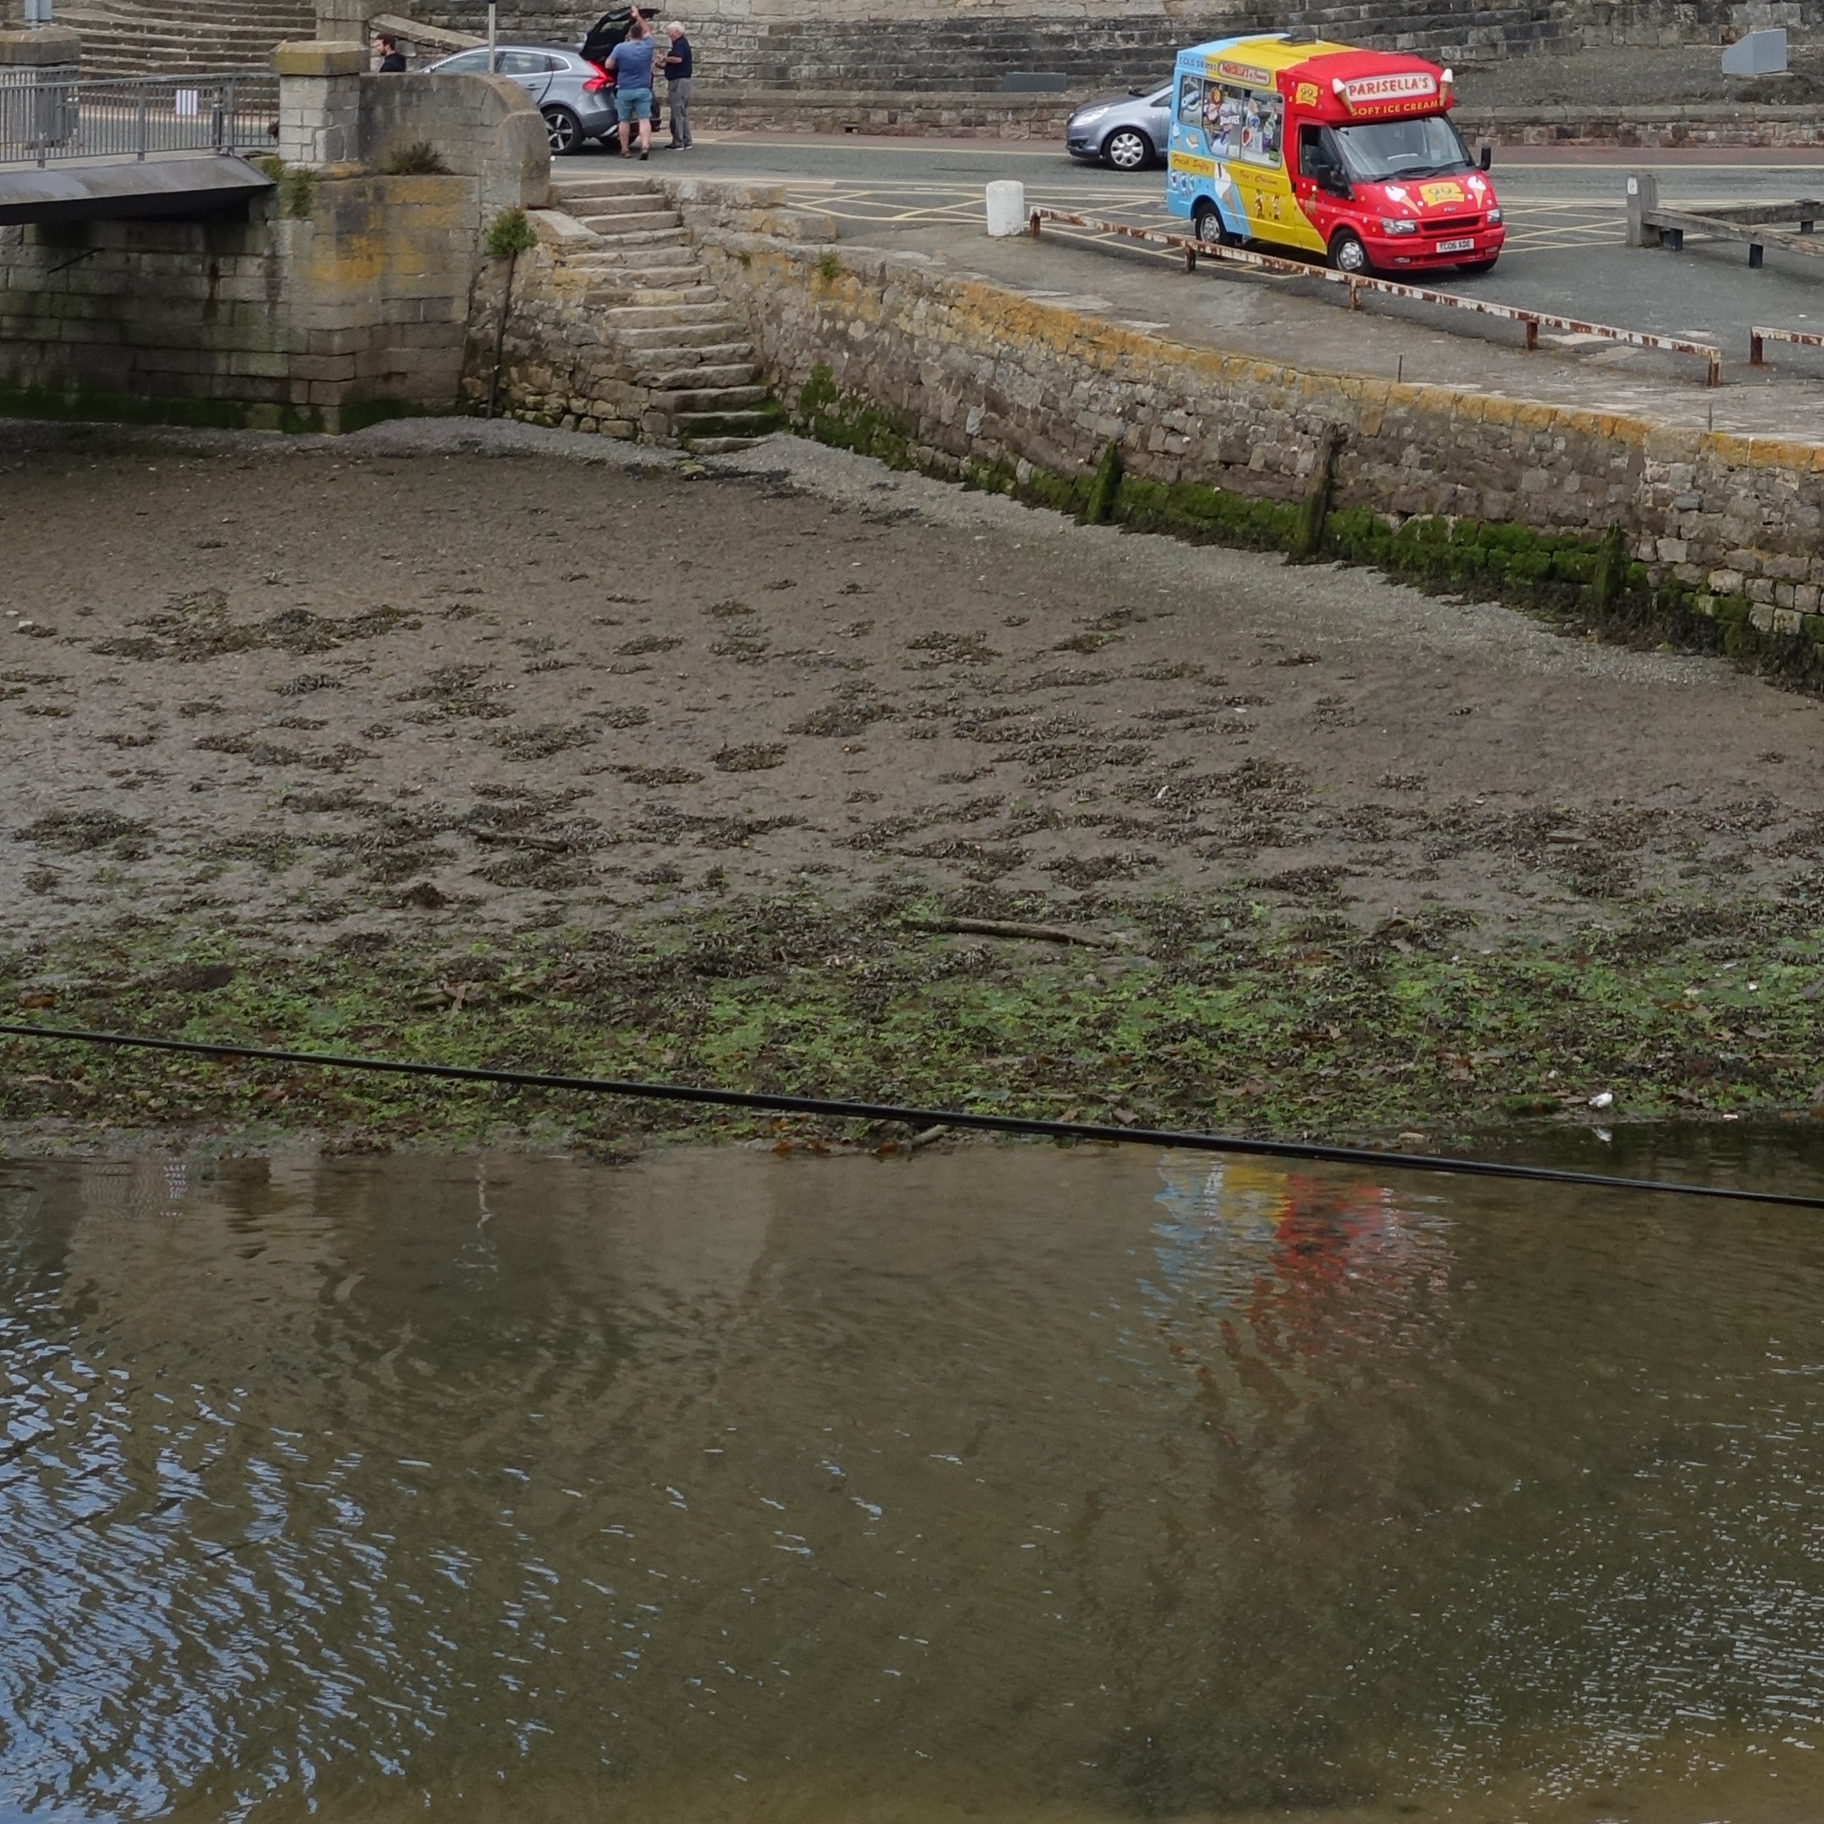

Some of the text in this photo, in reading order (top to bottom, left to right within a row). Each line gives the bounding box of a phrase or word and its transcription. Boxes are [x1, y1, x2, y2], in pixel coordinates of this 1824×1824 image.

[1348, 77, 1429, 97] PARISELLA'S
[1352, 100, 1438, 117] SOFT ICE CREAM
